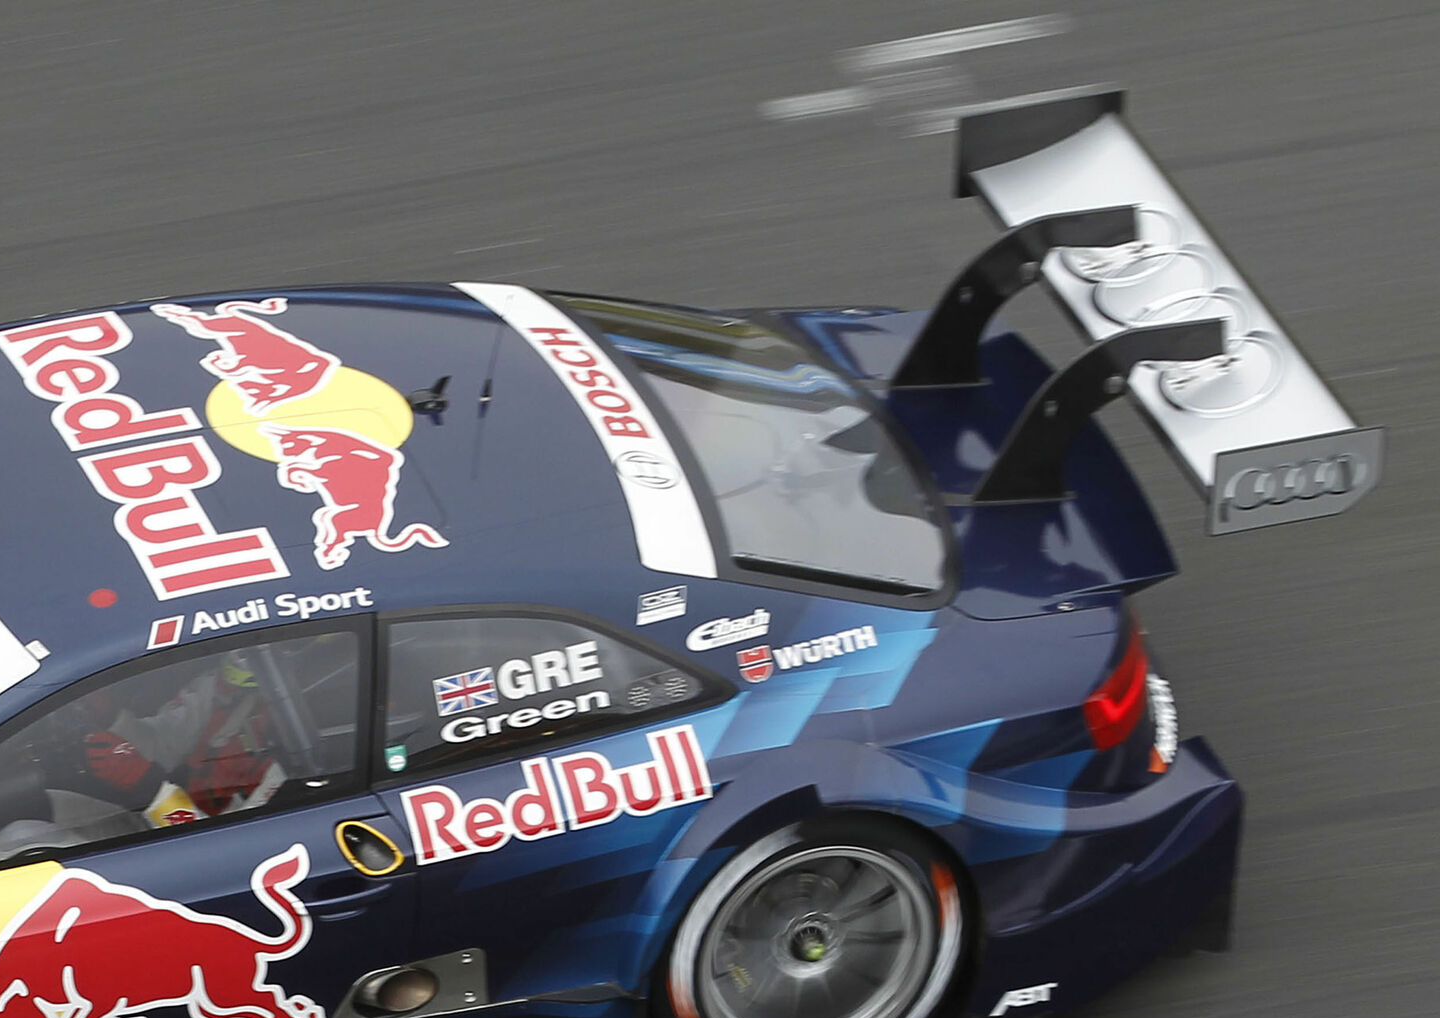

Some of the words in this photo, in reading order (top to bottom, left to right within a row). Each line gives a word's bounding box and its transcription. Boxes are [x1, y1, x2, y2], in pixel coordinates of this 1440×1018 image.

[529, 327, 652, 439] BOSCH
[191, 599, 270, 635] Audi
[275, 588, 373, 620] Sport
[498, 641, 604, 700] GRE
[440, 690, 611, 743] Green
